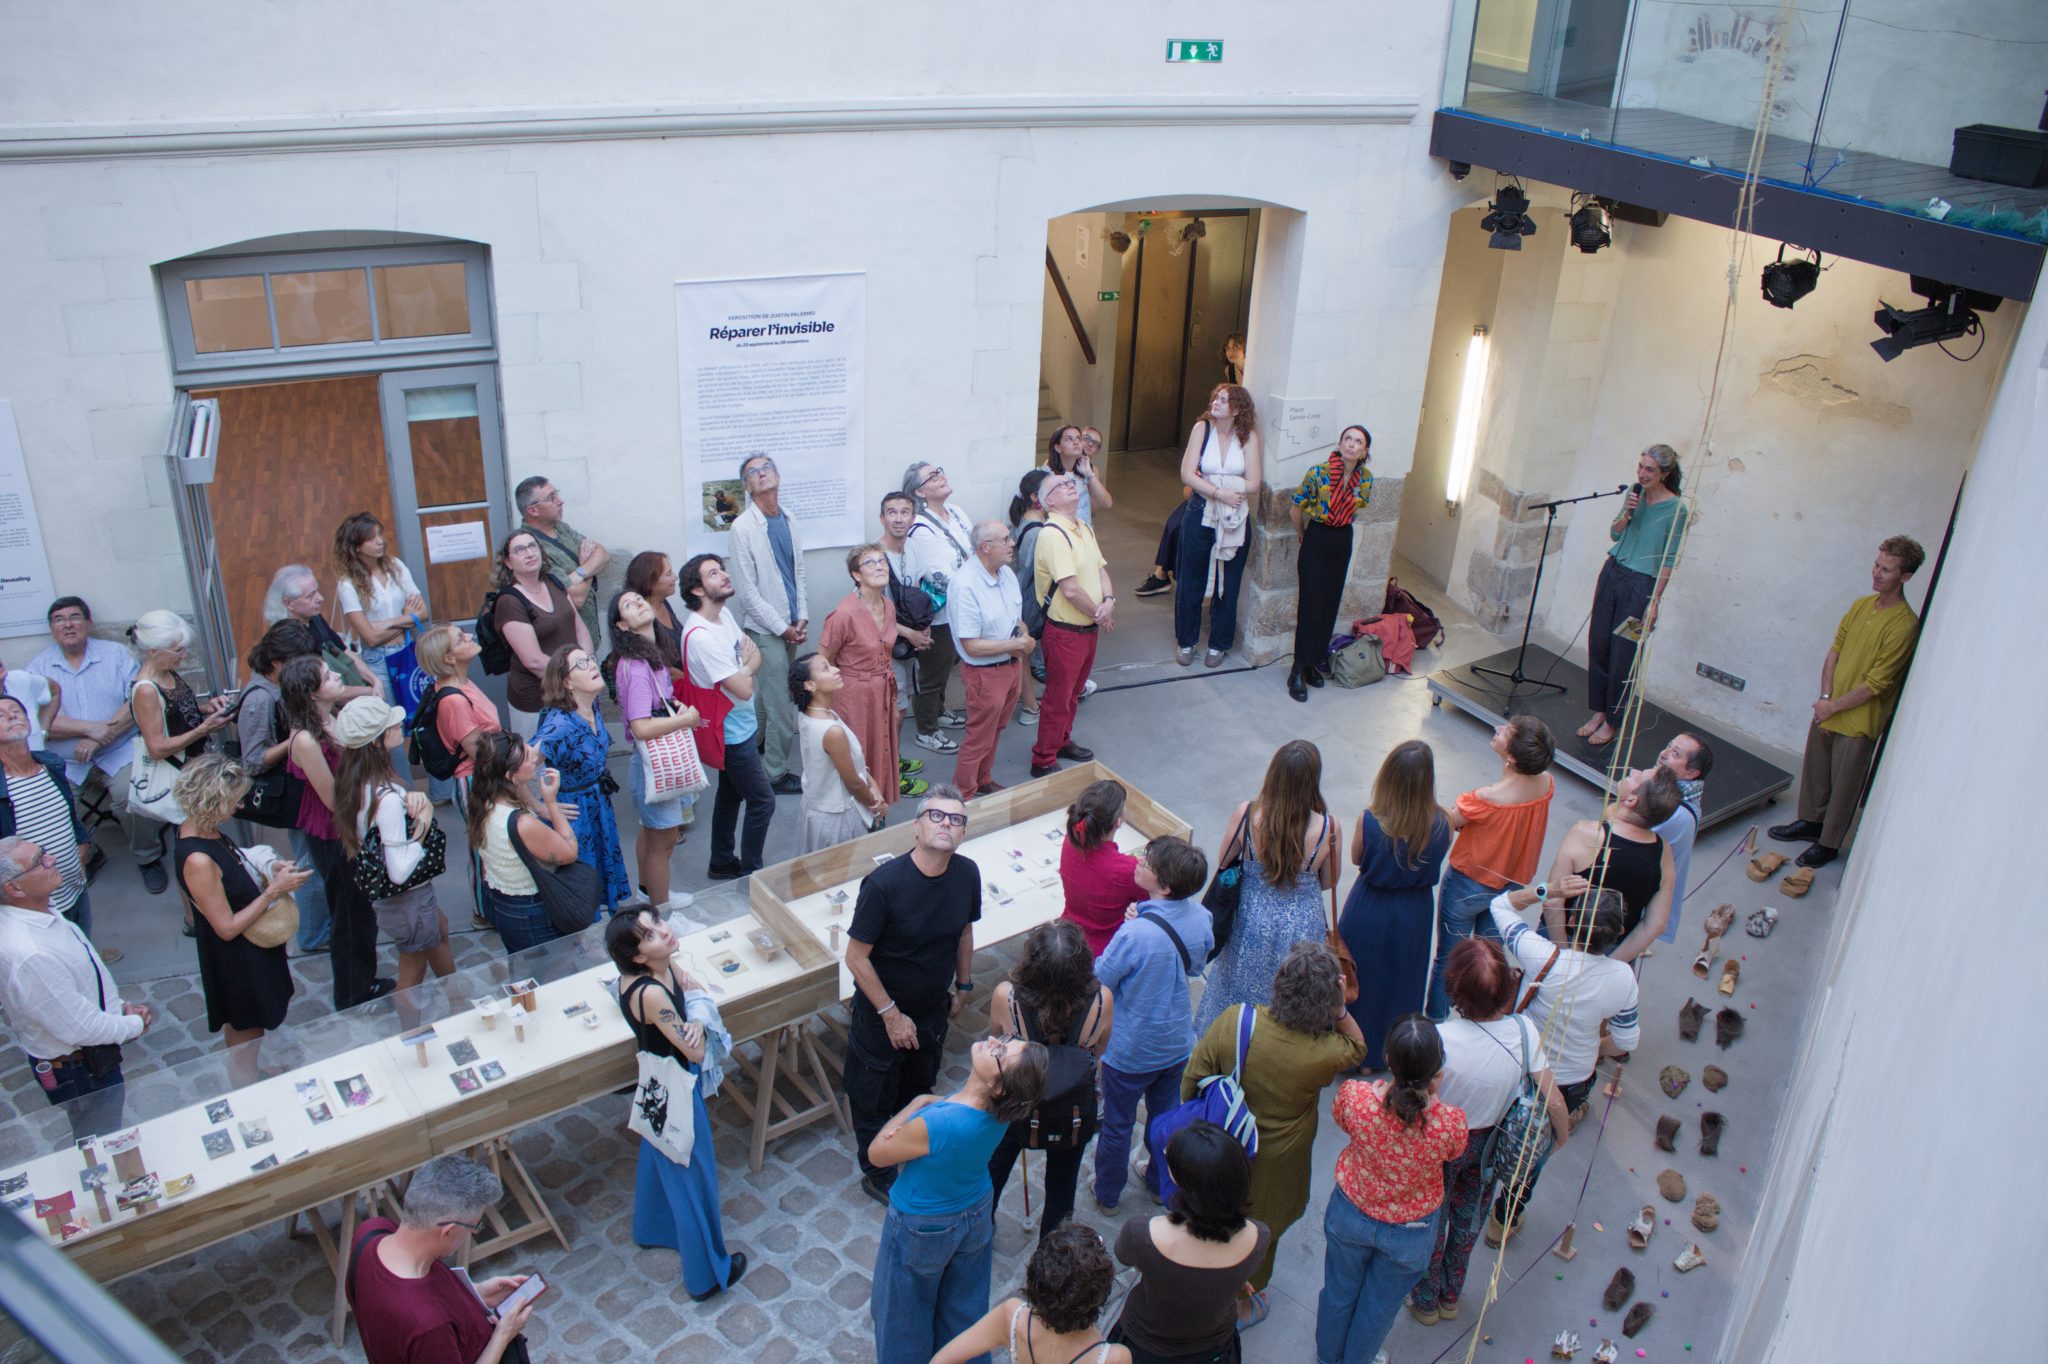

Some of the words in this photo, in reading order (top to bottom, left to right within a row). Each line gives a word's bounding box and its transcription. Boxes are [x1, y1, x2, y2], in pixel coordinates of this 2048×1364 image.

[728, 313, 761, 321] EXPOSITION
[770, 311, 790, 319] JUSTIN
[710, 326, 767, 341] Réparer
[768, 320, 835, 336] l’invisible
